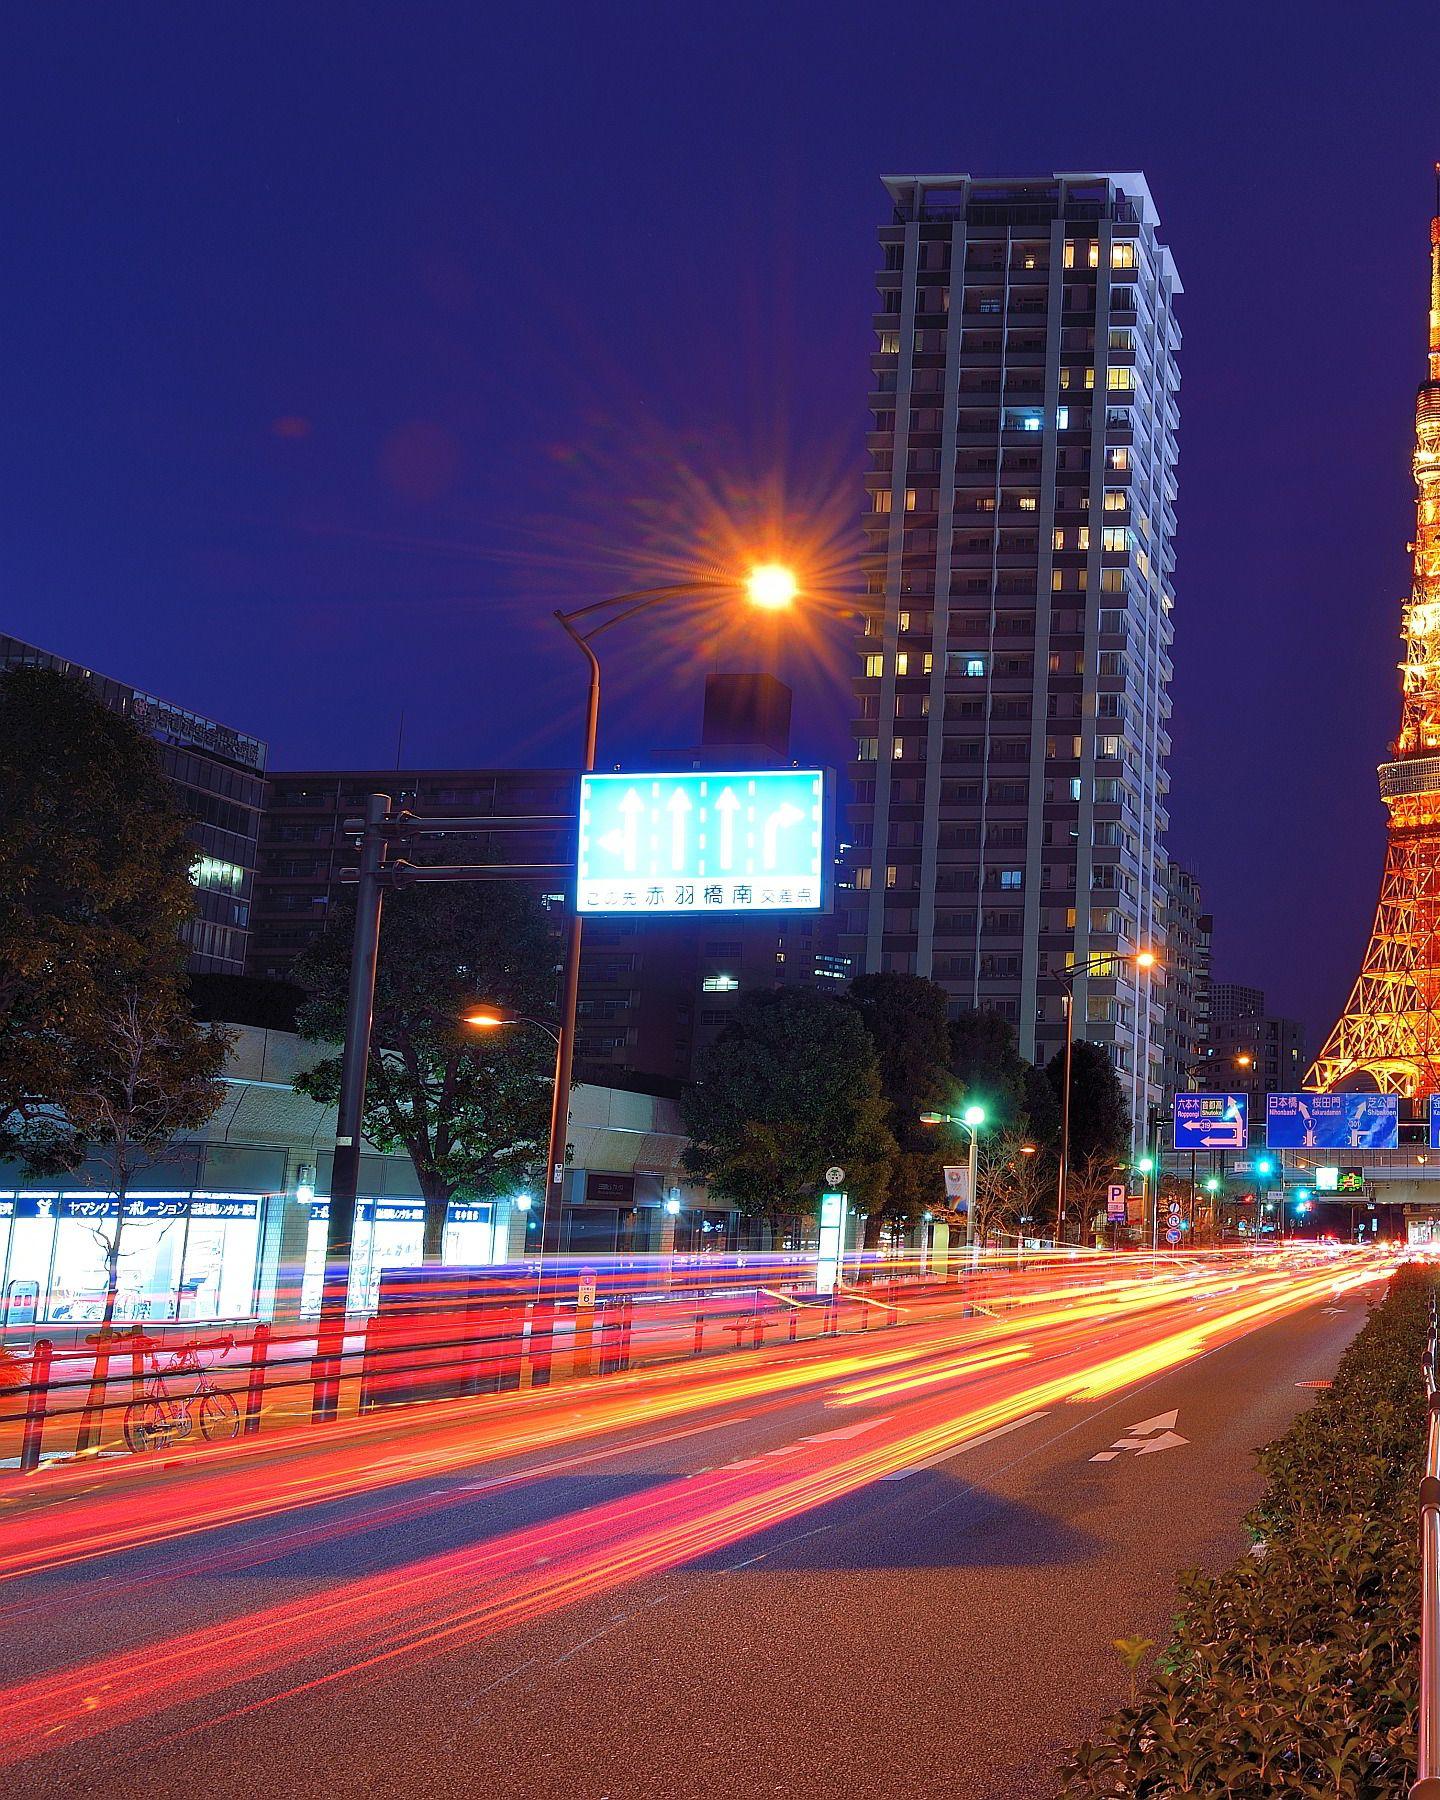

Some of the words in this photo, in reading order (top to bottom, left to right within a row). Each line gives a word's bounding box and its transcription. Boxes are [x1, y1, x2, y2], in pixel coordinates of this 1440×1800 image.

[645, 885, 752, 905] 赤羽橋南
[760, 888, 813, 903] 交差点
[1178, 1099, 1200, 1110] 六本木
[1269, 1097, 1298, 1108] 日本橋
[1312, 1097, 1341, 1108] 桜田門
[1367, 1097, 1396, 1108] 芝公園
[1177, 1111, 1200, 1119] Roppongi
[1112, 1187, 1122, 1201] P
[584, 1294, 590, 1303] 6
